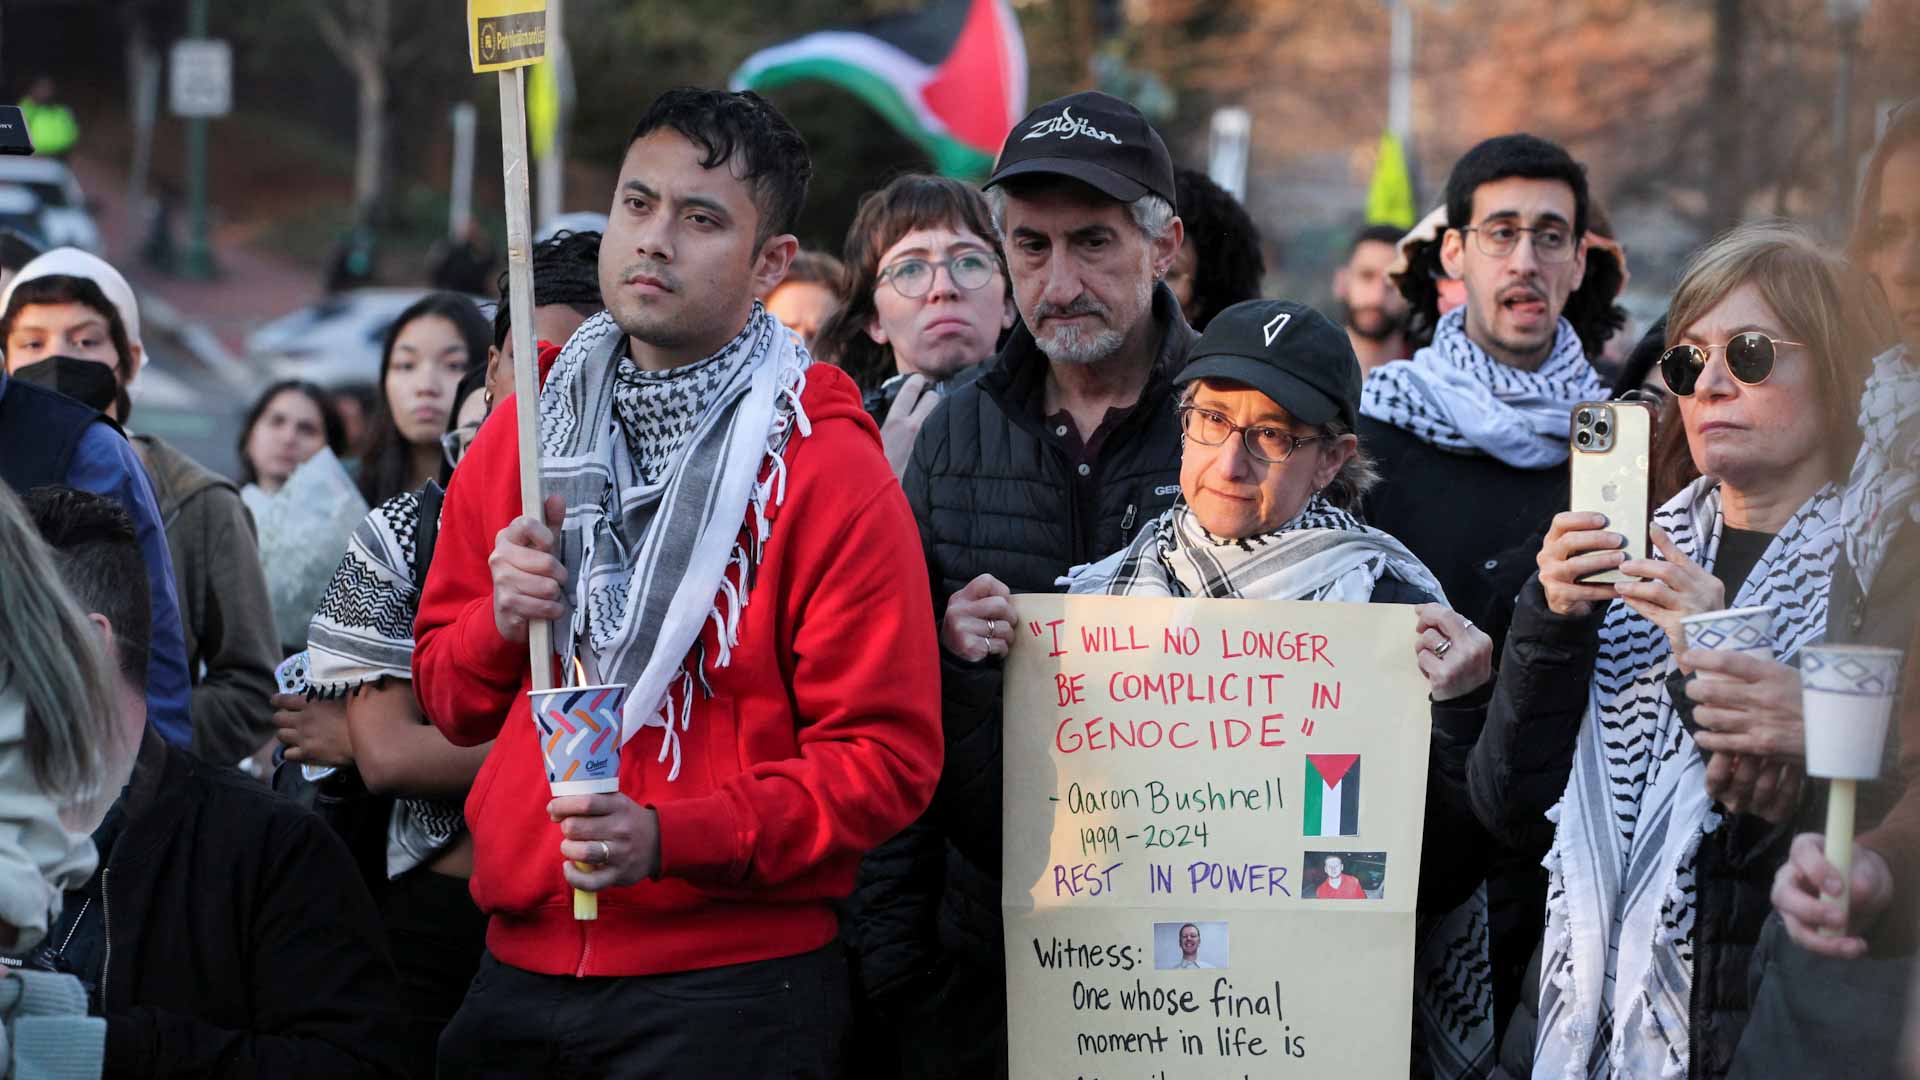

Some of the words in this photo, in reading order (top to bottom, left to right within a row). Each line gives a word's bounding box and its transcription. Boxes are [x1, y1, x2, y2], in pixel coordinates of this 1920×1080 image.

[1020, 106, 1122, 145] Zildjian
[1029, 619, 1068, 657] "I
[1081, 625, 1149, 653] WILL
[1164, 627, 1200, 656] NO
[1222, 629, 1335, 667] LONGER
[1054, 672, 1085, 707] BE
[1109, 672, 1284, 707] COMPLICIT
[1312, 681, 1341, 709] IN
[1149, 777, 1283, 814] Bushnell
[1053, 861, 1123, 896] REST
[1150, 864, 1171, 893] IN
[1188, 863, 1291, 896] POWER
[1033, 937, 1143, 971] Witness:
[1073, 981, 1111, 1010] One
[1120, 979, 1200, 1016] whose
[1209, 977, 1282, 1021] final
[1077, 1026, 1168, 1055] moment
[1179, 1029, 1203, 1055] in
[1217, 1027, 1267, 1056] life
[1285, 1026, 1305, 1058] is
